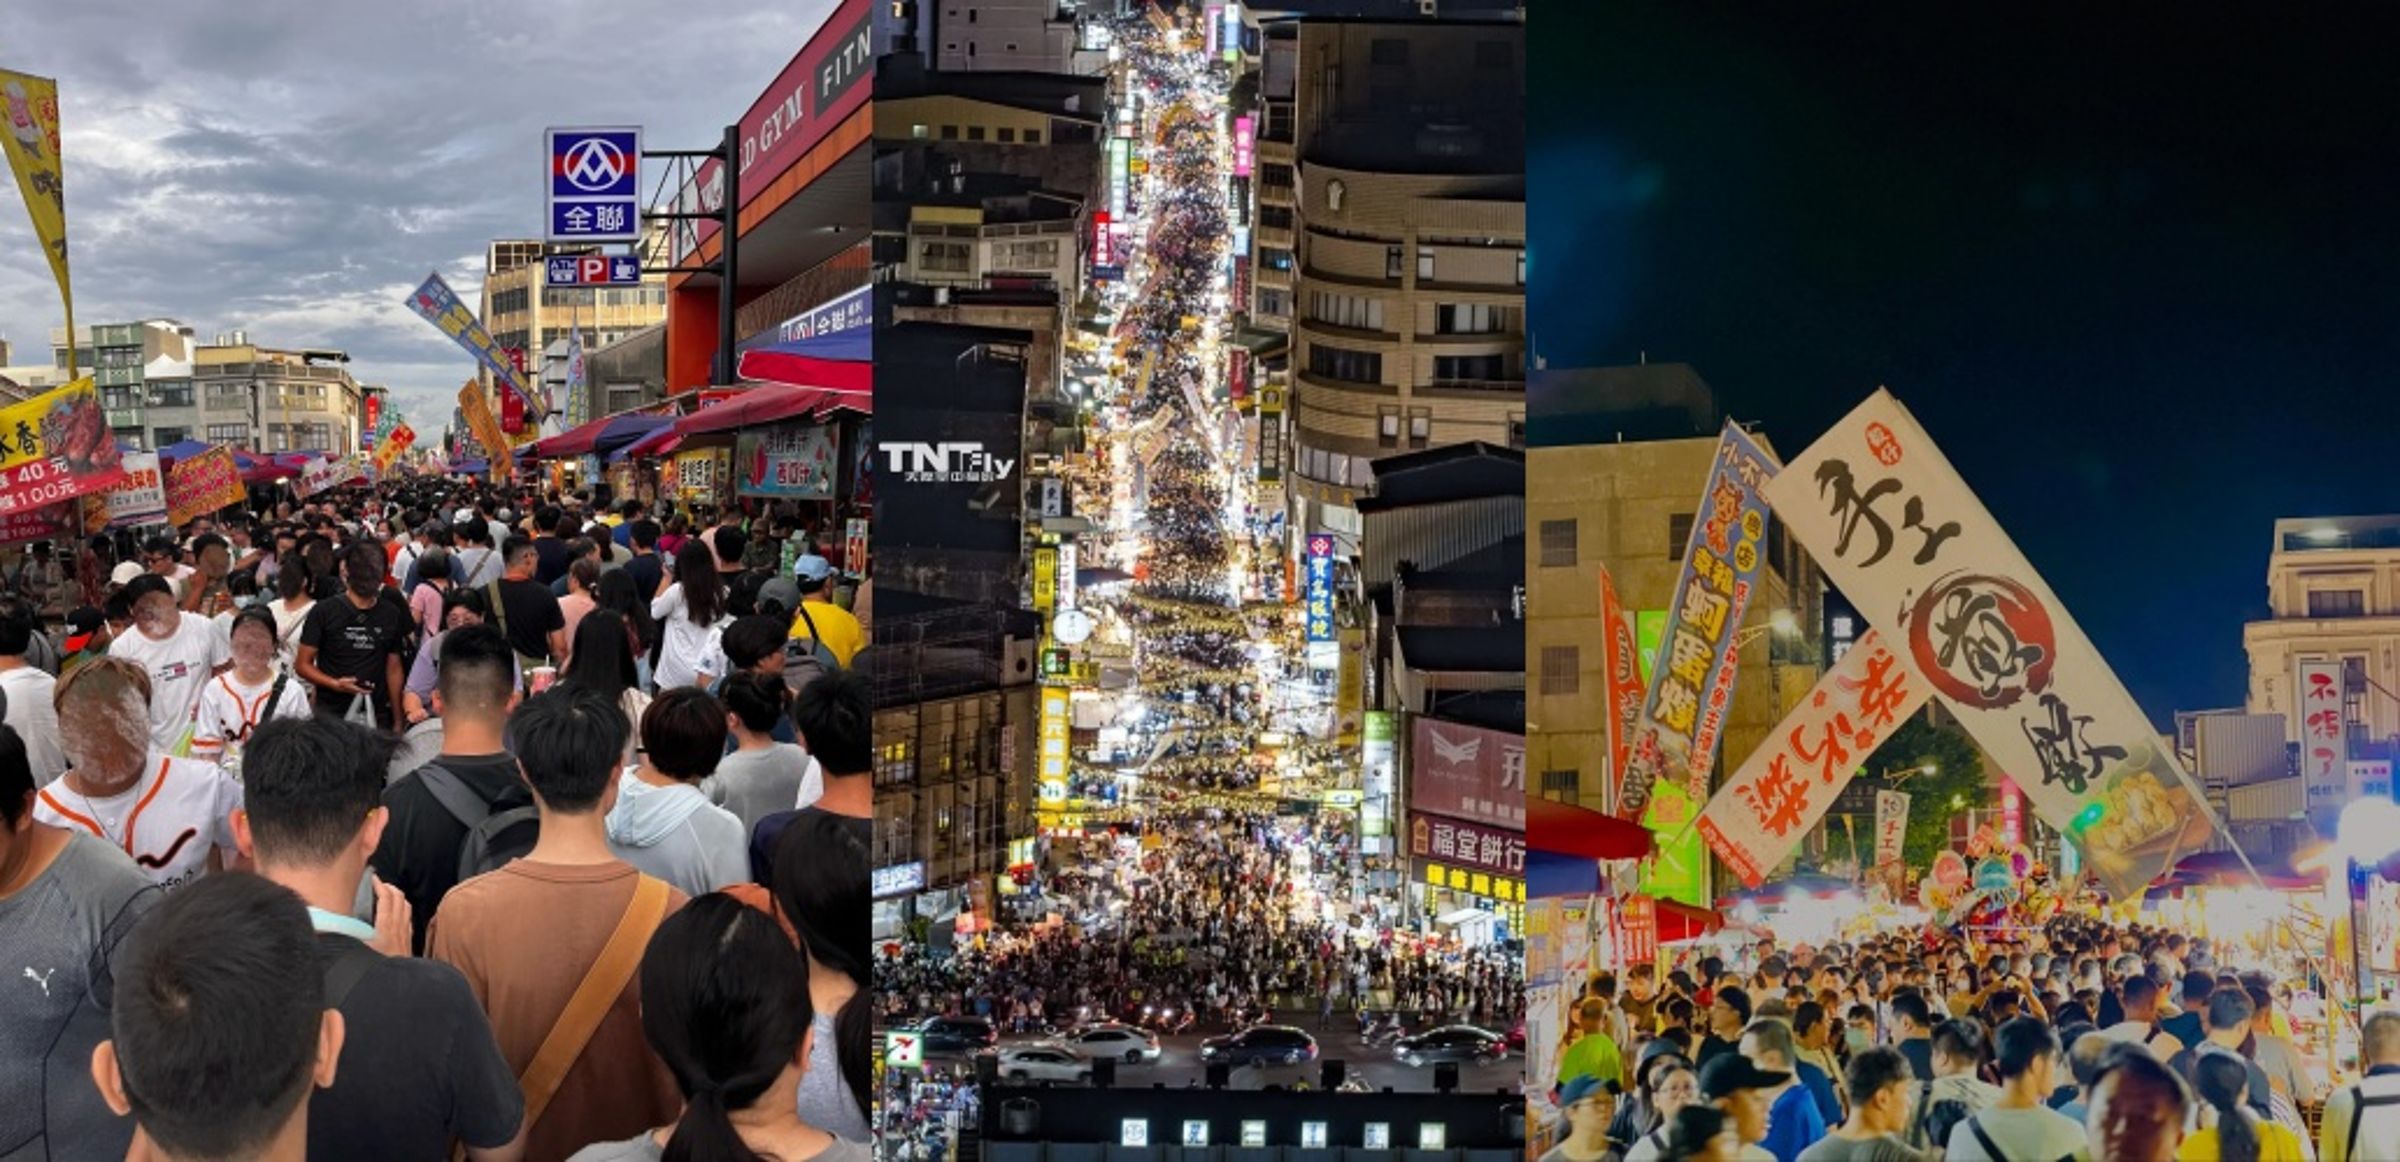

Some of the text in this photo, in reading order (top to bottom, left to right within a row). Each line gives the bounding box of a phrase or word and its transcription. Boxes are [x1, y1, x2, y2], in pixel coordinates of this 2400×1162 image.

[821, 25, 872, 99] FITN
[759, 84, 808, 153] GYM
[564, 205, 625, 232] 全聯
[550, 259, 576, 270] ATM
[583, 259, 604, 283] P
[18, 463, 45, 484] 40
[1311, 556, 1330, 640] 寶島眼鏡
[2306, 672, 2341, 777] 不得了
